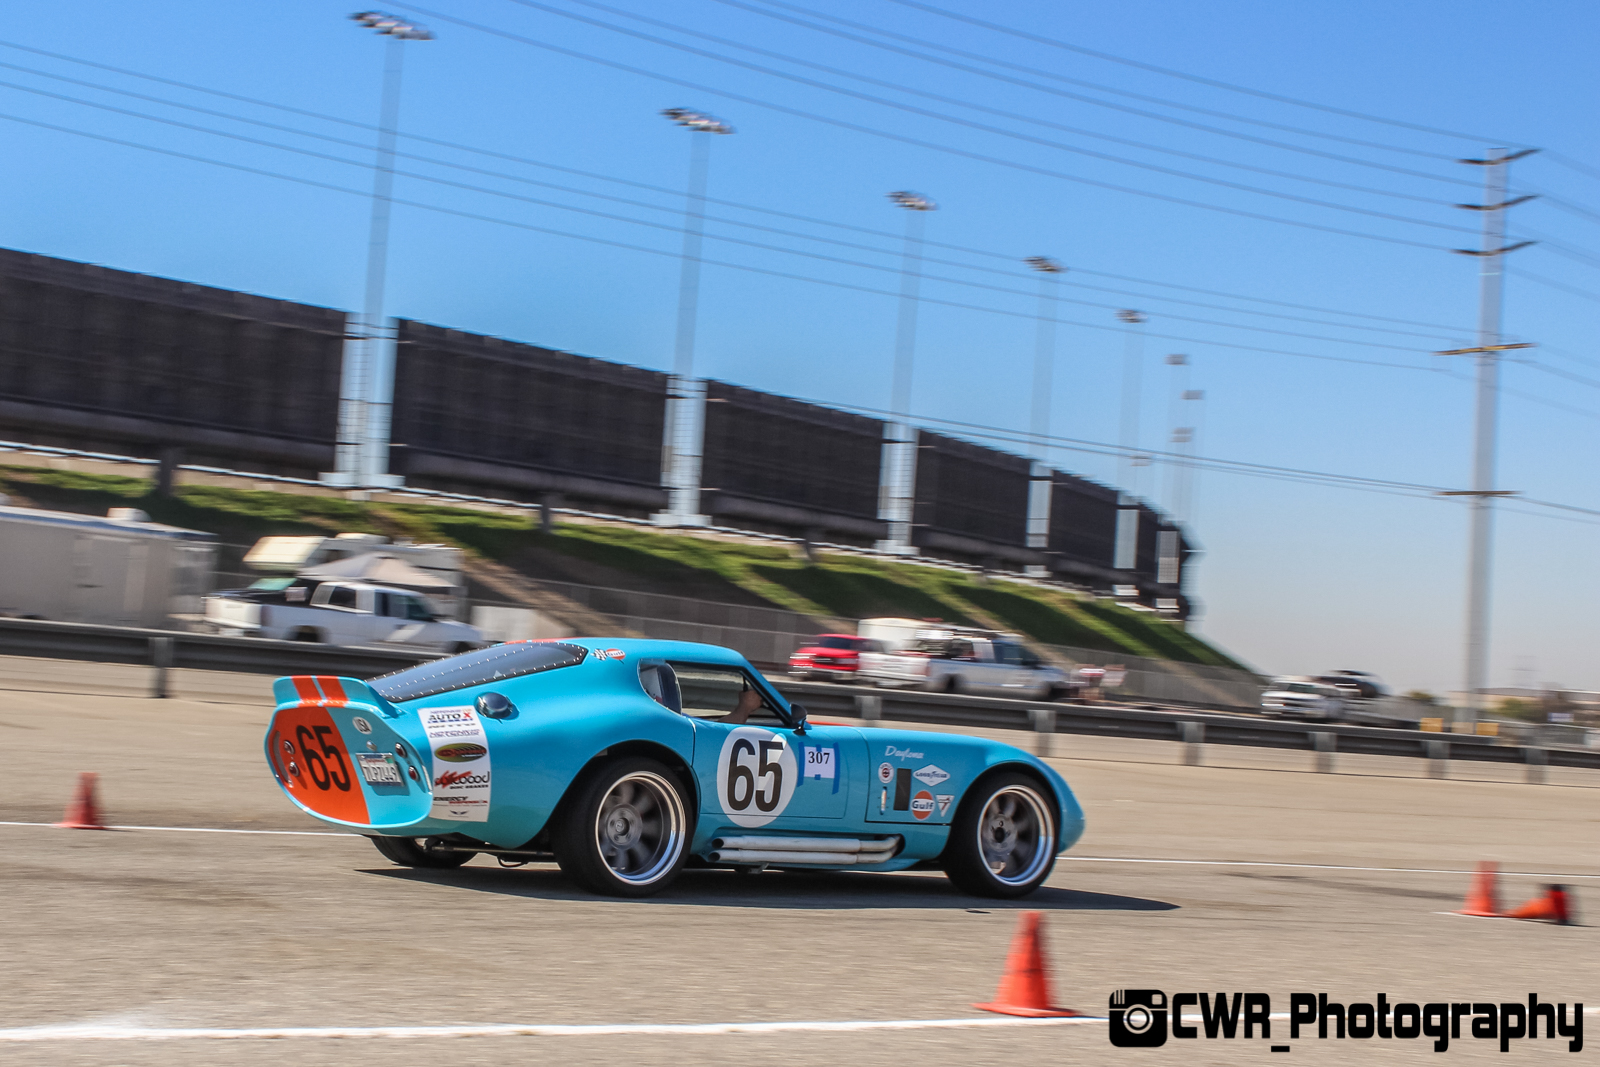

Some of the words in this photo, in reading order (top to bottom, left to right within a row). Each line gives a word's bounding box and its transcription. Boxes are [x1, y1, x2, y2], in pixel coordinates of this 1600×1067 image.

[355, 719, 371, 732] USA
[296, 725, 351, 792] 65
[808, 751, 831, 764] 307
[885, 745, 924, 761] Daytona
[727, 738, 784, 812] 65
[912, 800, 934, 810] Gulf
